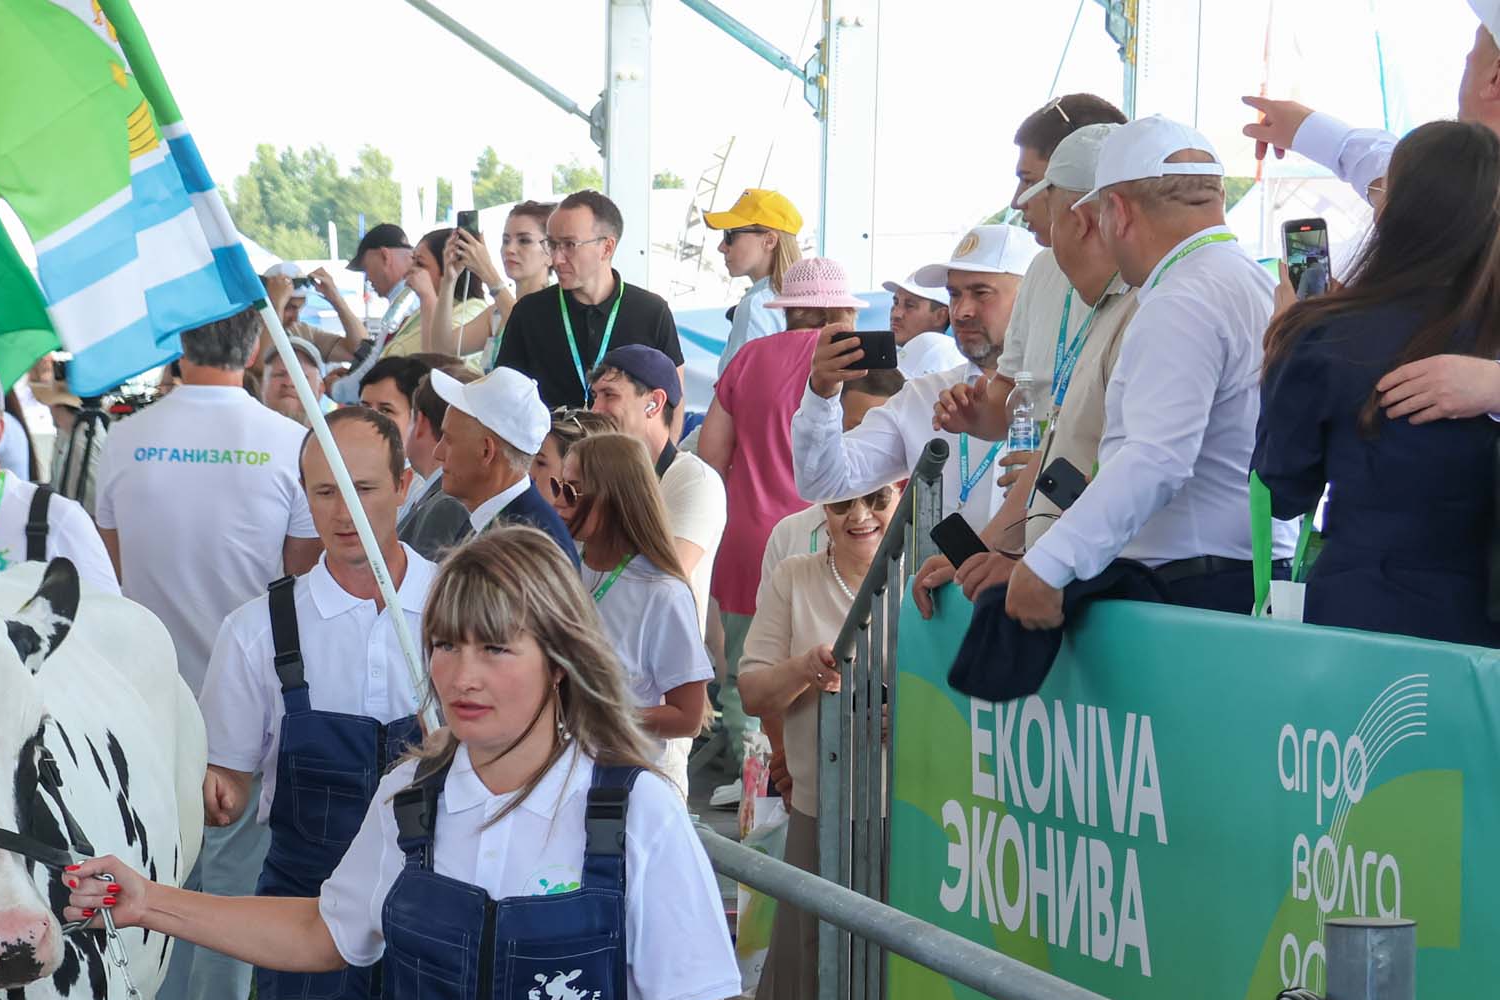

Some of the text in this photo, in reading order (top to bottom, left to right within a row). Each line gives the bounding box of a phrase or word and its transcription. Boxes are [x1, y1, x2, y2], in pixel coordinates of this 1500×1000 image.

[133, 446, 270, 466] ОРГАНИЗАТОР
[970, 694, 1169, 845] EKONIVA
[1278, 723, 1367, 826] агро
[939, 799, 1153, 978] ЭКОНИВА
[1292, 833, 1401, 921] волга
